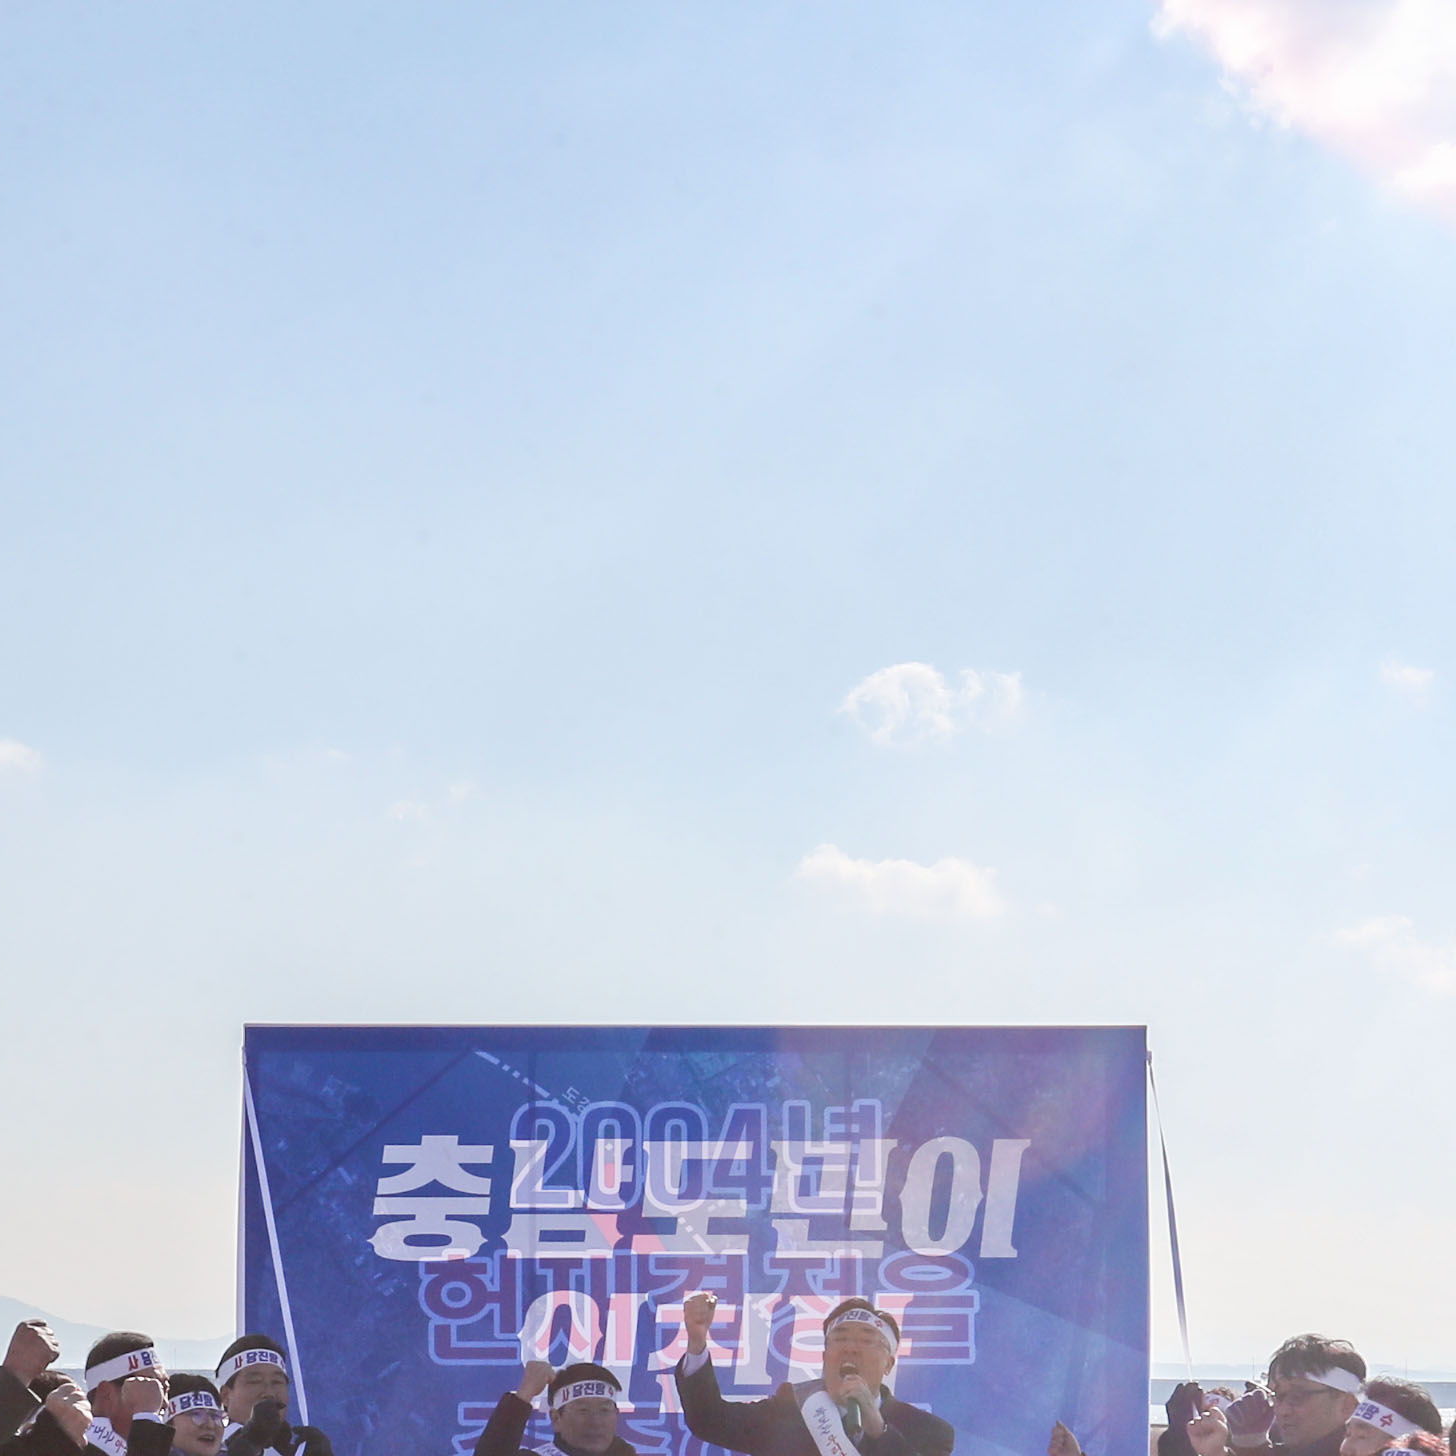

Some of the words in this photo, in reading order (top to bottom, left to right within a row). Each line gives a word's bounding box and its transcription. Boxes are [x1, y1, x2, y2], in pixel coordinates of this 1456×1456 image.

[367, 1134, 1031, 1261] 충남도민이
[510, 1099, 882, 1215] 2004년
[1380, 1413, 1393, 1427] 수
